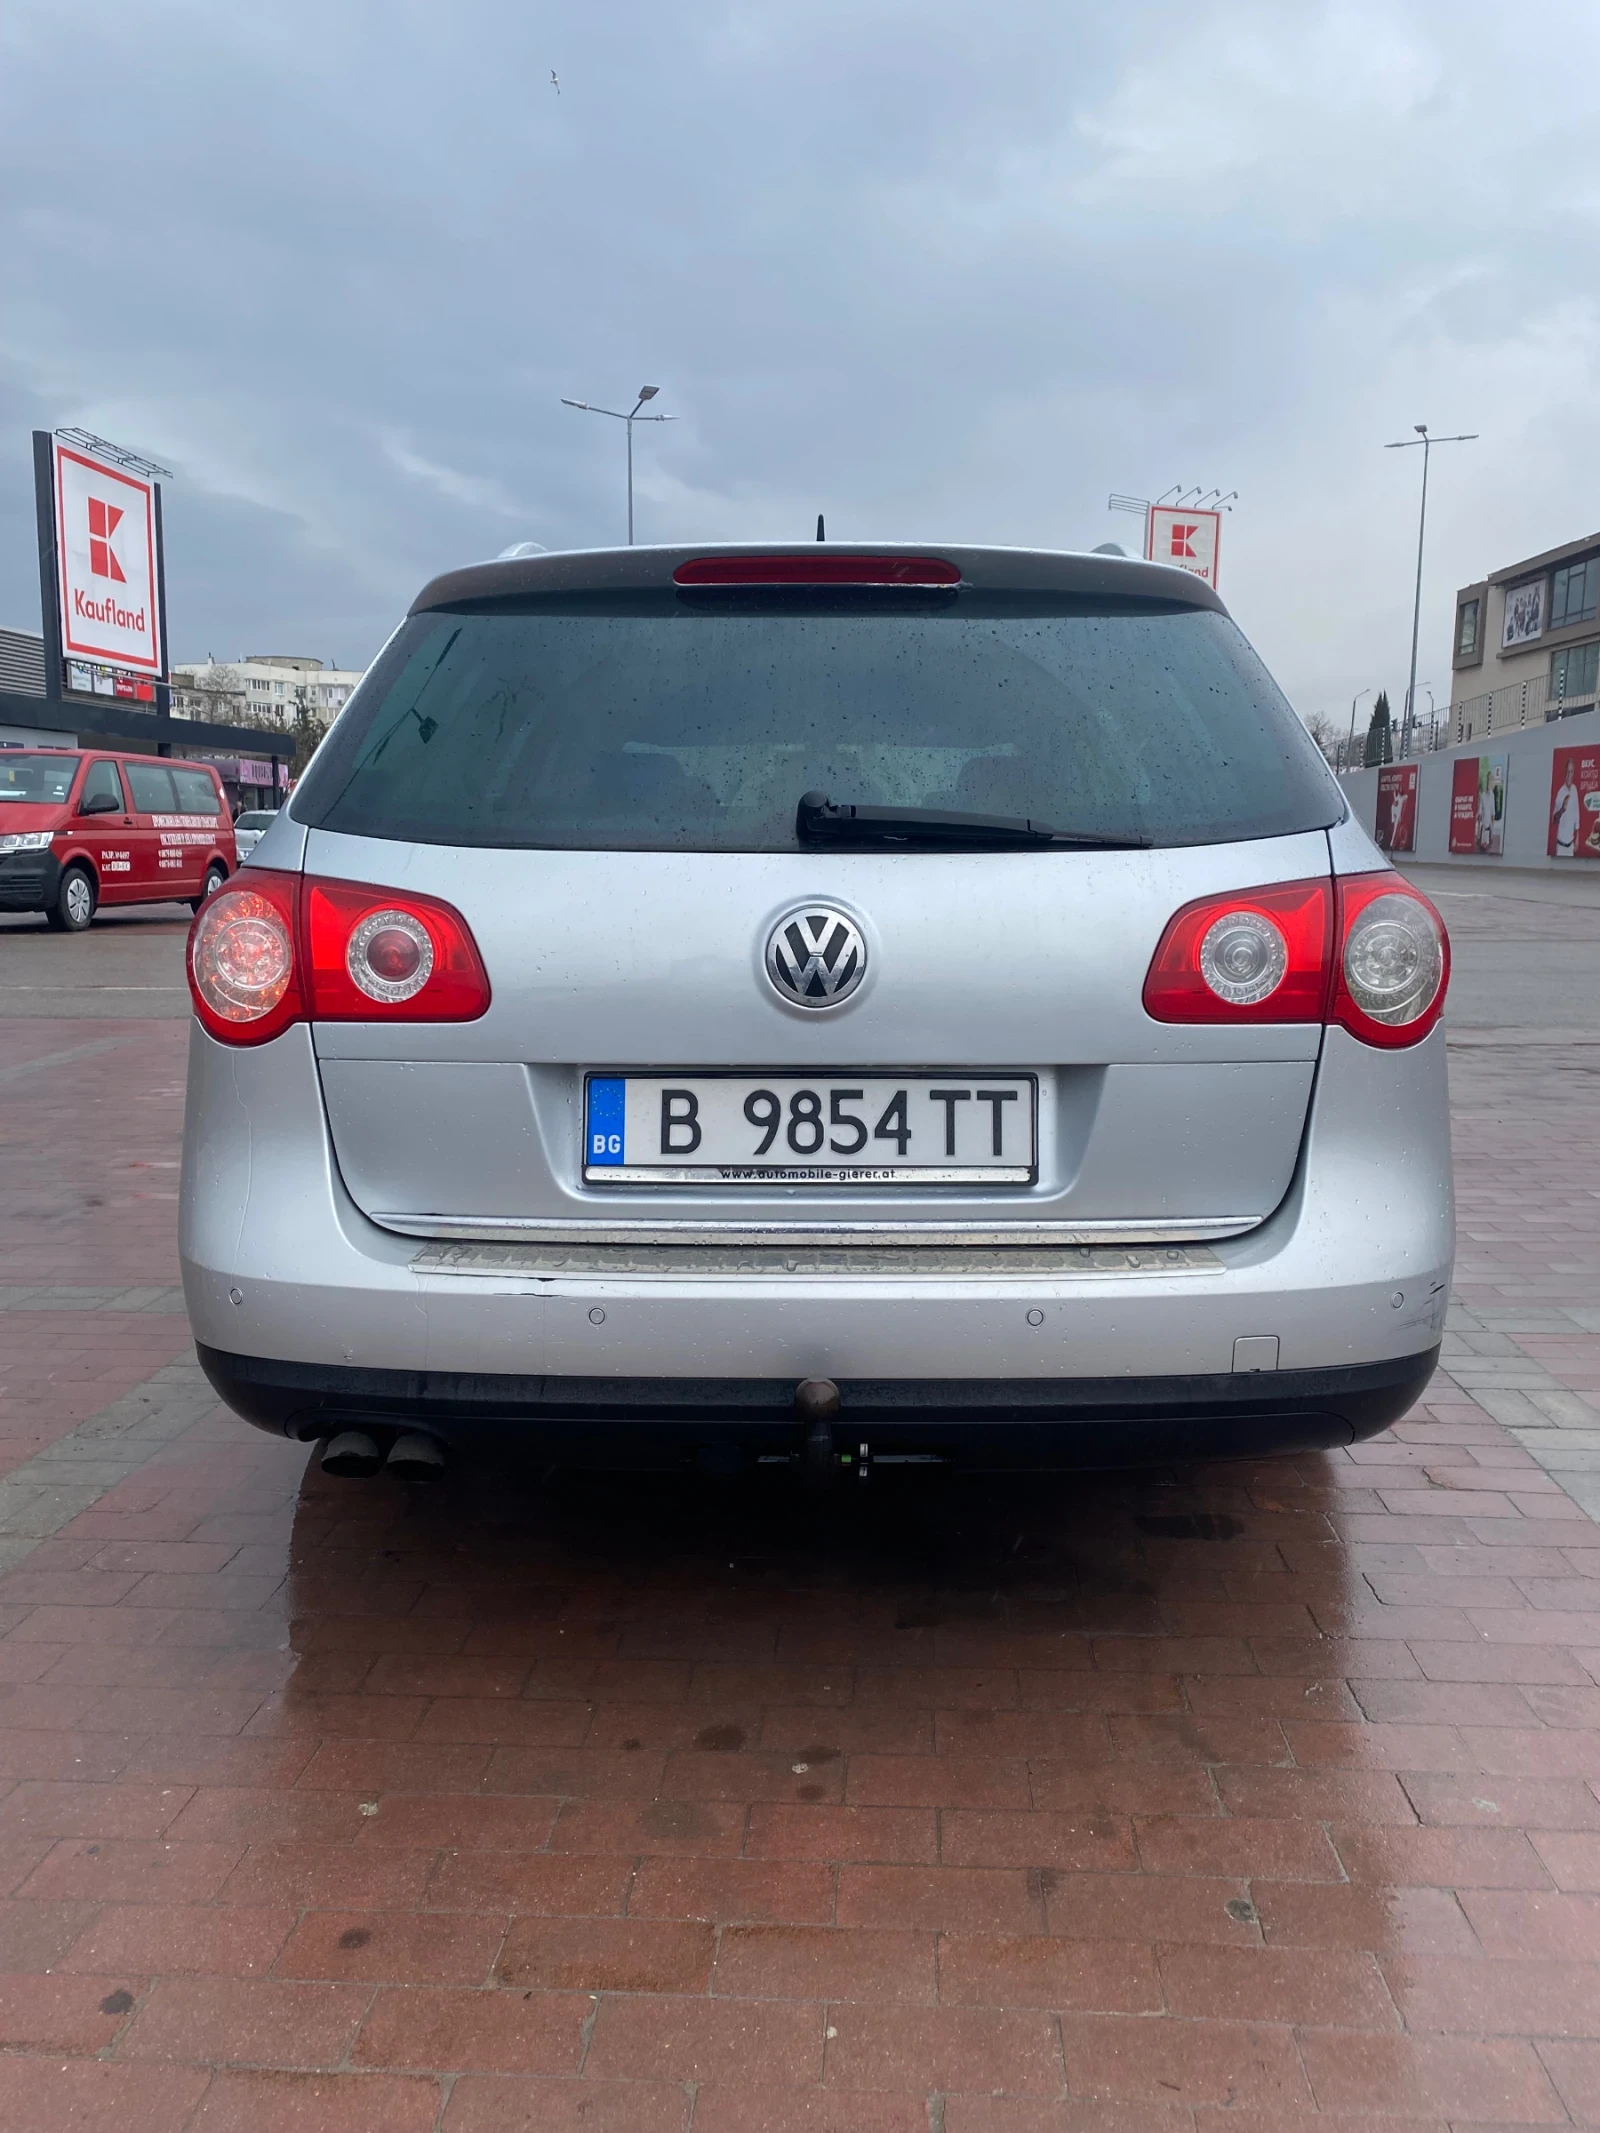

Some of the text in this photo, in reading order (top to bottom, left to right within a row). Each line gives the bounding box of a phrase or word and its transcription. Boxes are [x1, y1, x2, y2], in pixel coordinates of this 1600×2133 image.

[74, 588, 146, 632] Kaufland
[592, 1089, 1018, 1156] BG B 9854 TT
[720, 1167, 896, 1181] www.automobile-gierer.at
